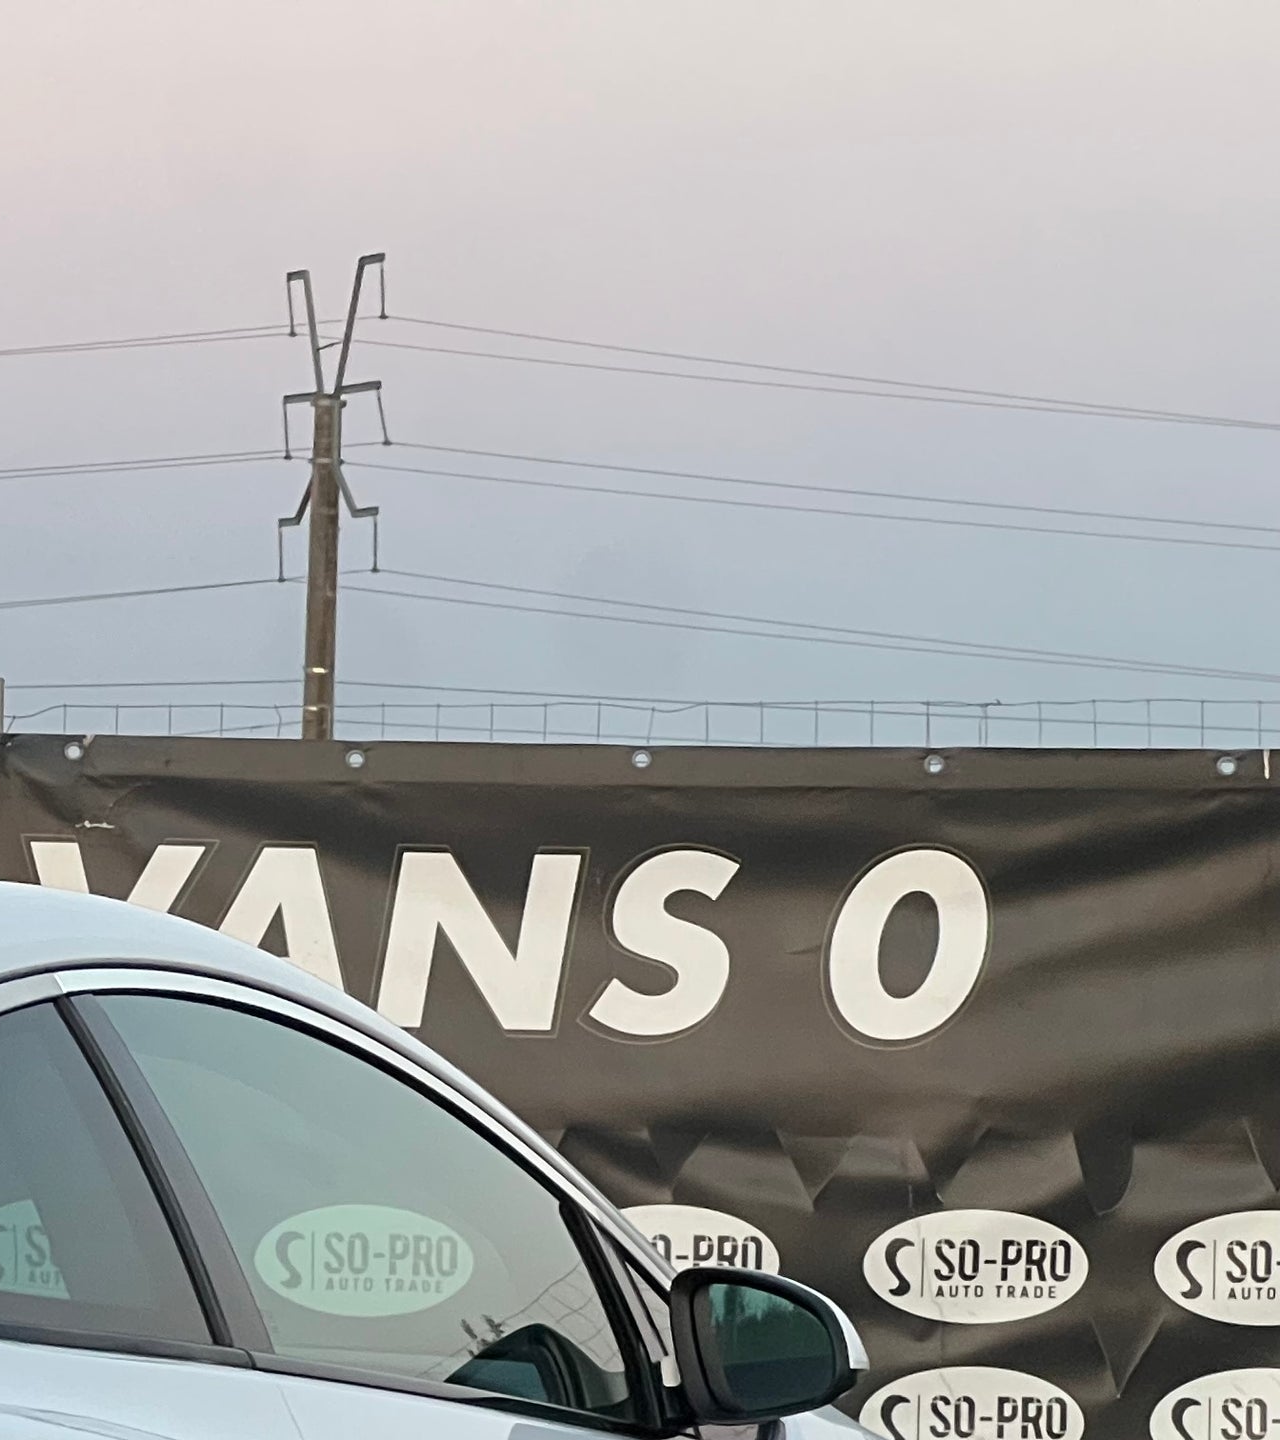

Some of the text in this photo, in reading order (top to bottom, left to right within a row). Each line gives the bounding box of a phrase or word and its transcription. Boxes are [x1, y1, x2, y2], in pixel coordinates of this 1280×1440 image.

[324, 1231, 459, 1277] SO-PRO
[653, 1234, 762, 1270] O-PRO
[934, 1239, 1071, 1282] SO-PRO
[325, 1277, 445, 1294] AUTO TRADE
[936, 1285, 1056, 1298] AUTO TRADE
[1228, 1287, 1276, 1300] AUTO
[930, 1394, 1069, 1439] SO-PRO
